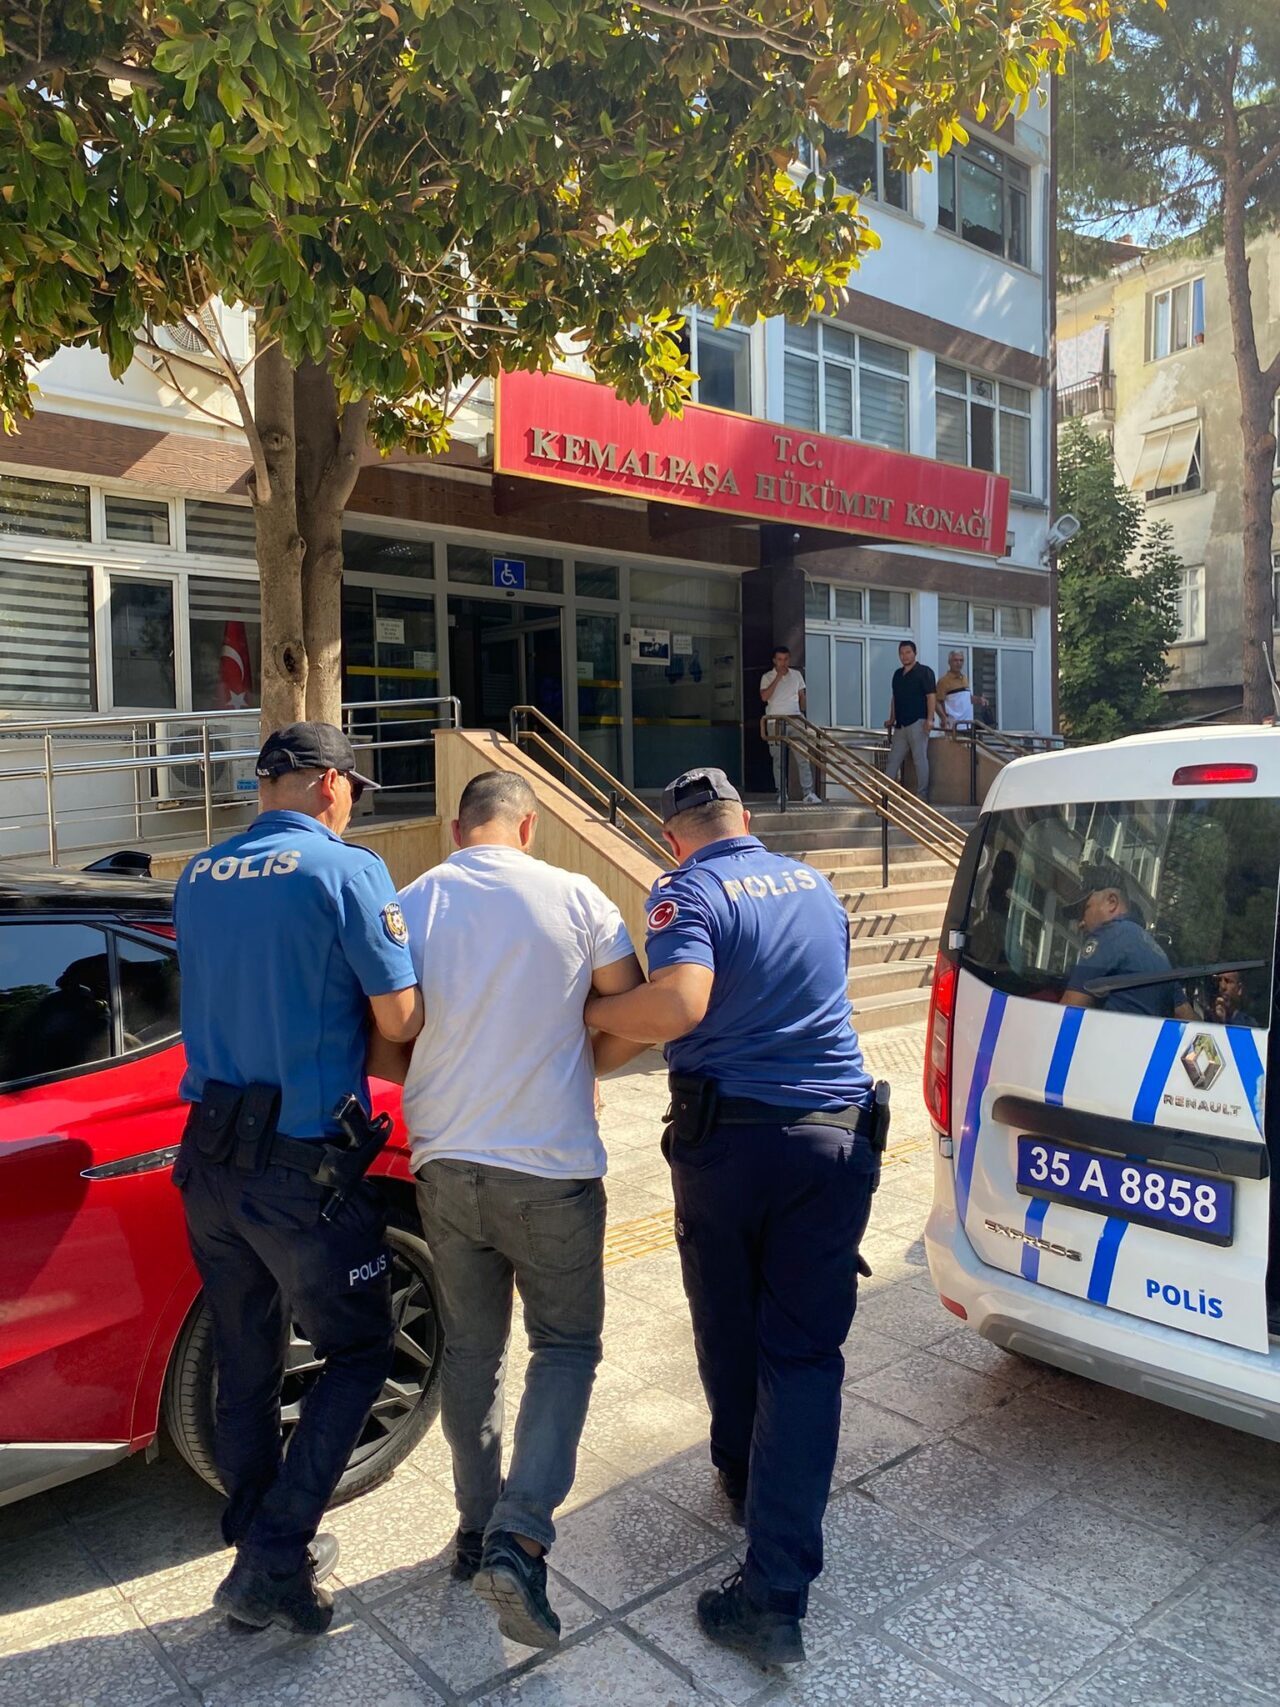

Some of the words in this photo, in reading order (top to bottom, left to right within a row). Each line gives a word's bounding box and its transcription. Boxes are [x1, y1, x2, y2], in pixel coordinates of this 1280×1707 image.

[773, 434, 823, 469] T.C.
[531, 426, 740, 496] KEMALPAŞA
[754, 469, 895, 523] HÜKÜMET
[904, 502, 990, 539] KONAĞI
[1163, 1093, 1242, 1117] RENAULT
[1029, 1146, 1070, 1187] 35
[1079, 1159, 1109, 1198] A
[1119, 1167, 1217, 1224] 8858
[984, 1218, 1083, 1262] EXPRESS
[1145, 1278, 1223, 1319] POLİS
